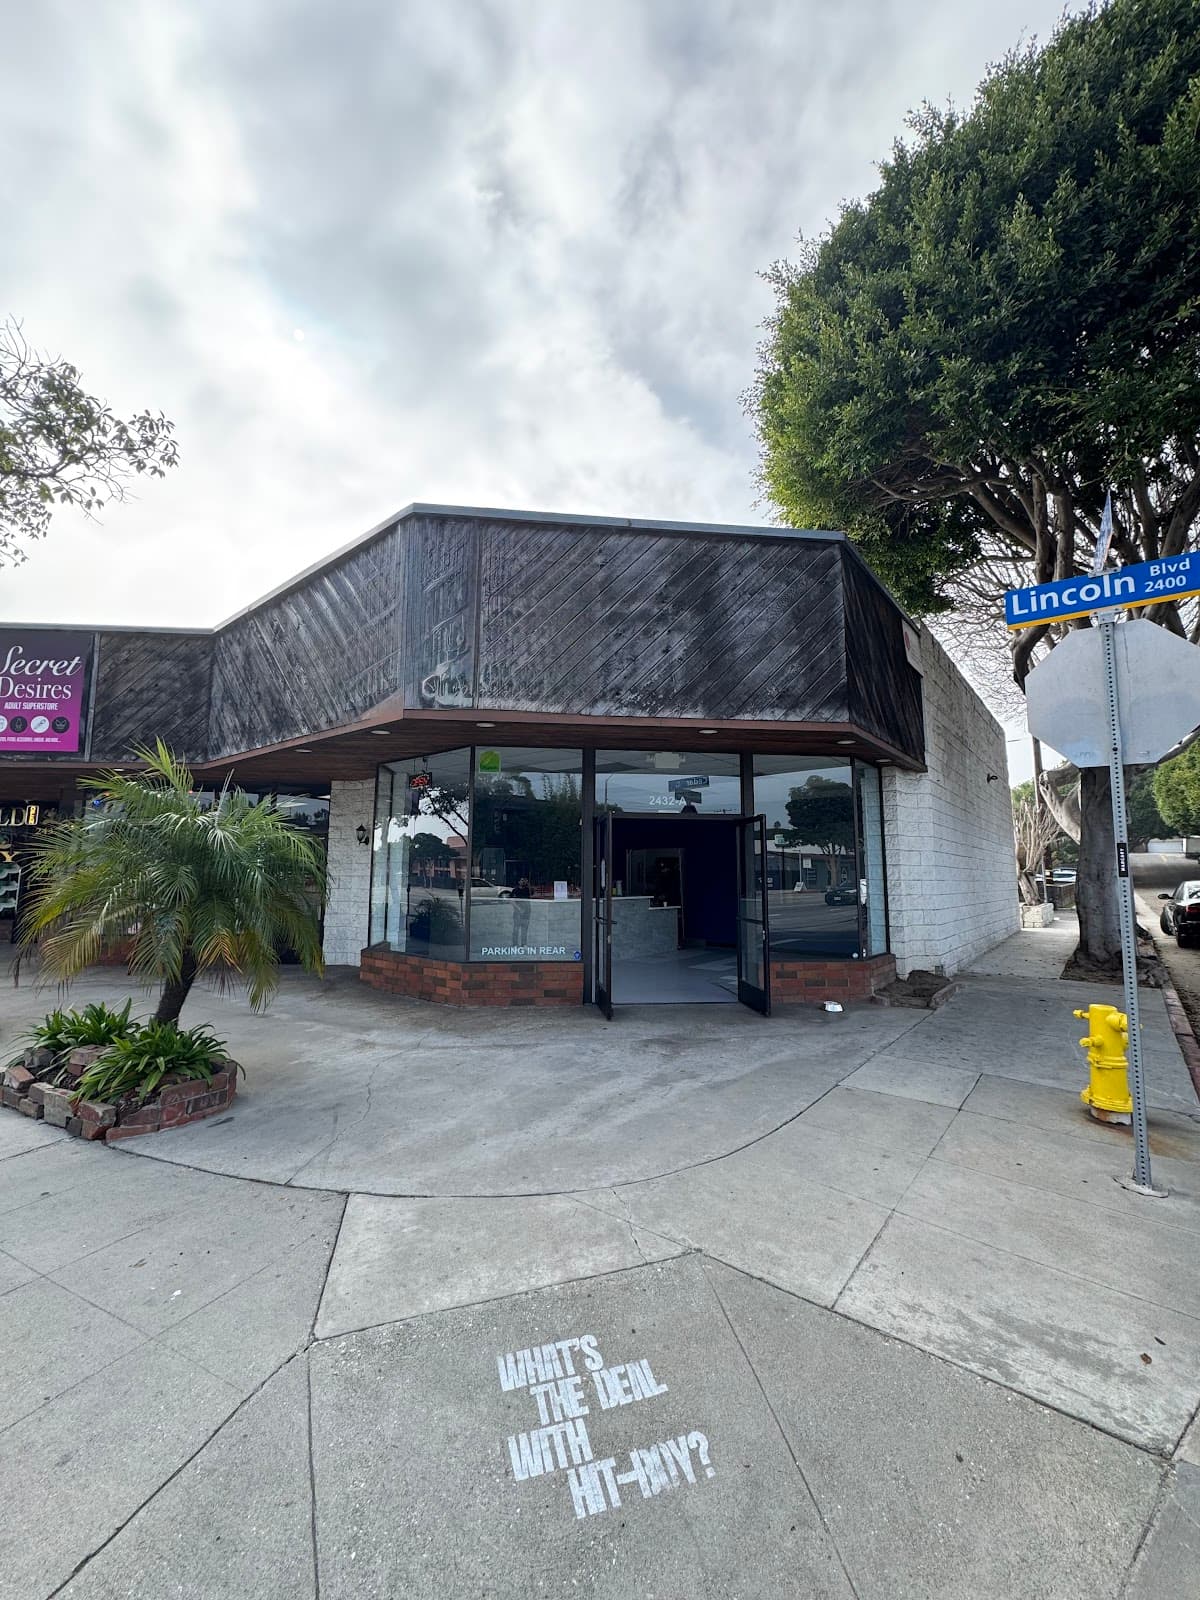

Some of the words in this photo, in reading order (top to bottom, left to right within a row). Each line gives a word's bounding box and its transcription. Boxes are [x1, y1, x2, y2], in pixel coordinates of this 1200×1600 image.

[1012, 575, 1135, 616] Lincoln
[1150, 558, 1190, 577] Blvd
[1144, 575, 1187, 593] 2400
[0, 645, 82, 676] Secret
[0, 676, 72, 699] Desires
[4, 701, 21, 710] ADULT
[22, 702, 59, 711] SUPERSTORE
[649, 796, 687, 806] 2432-A
[481, 946, 525, 955] PARKING
[527, 946, 536, 955] IN
[539, 946, 566, 955] REAR
[496, 1334, 604, 1392] WHAT'S
[529, 1375, 590, 1426] THE
[592, 1358, 669, 1410] DEAL
[507, 1418, 593, 1482] WITH
